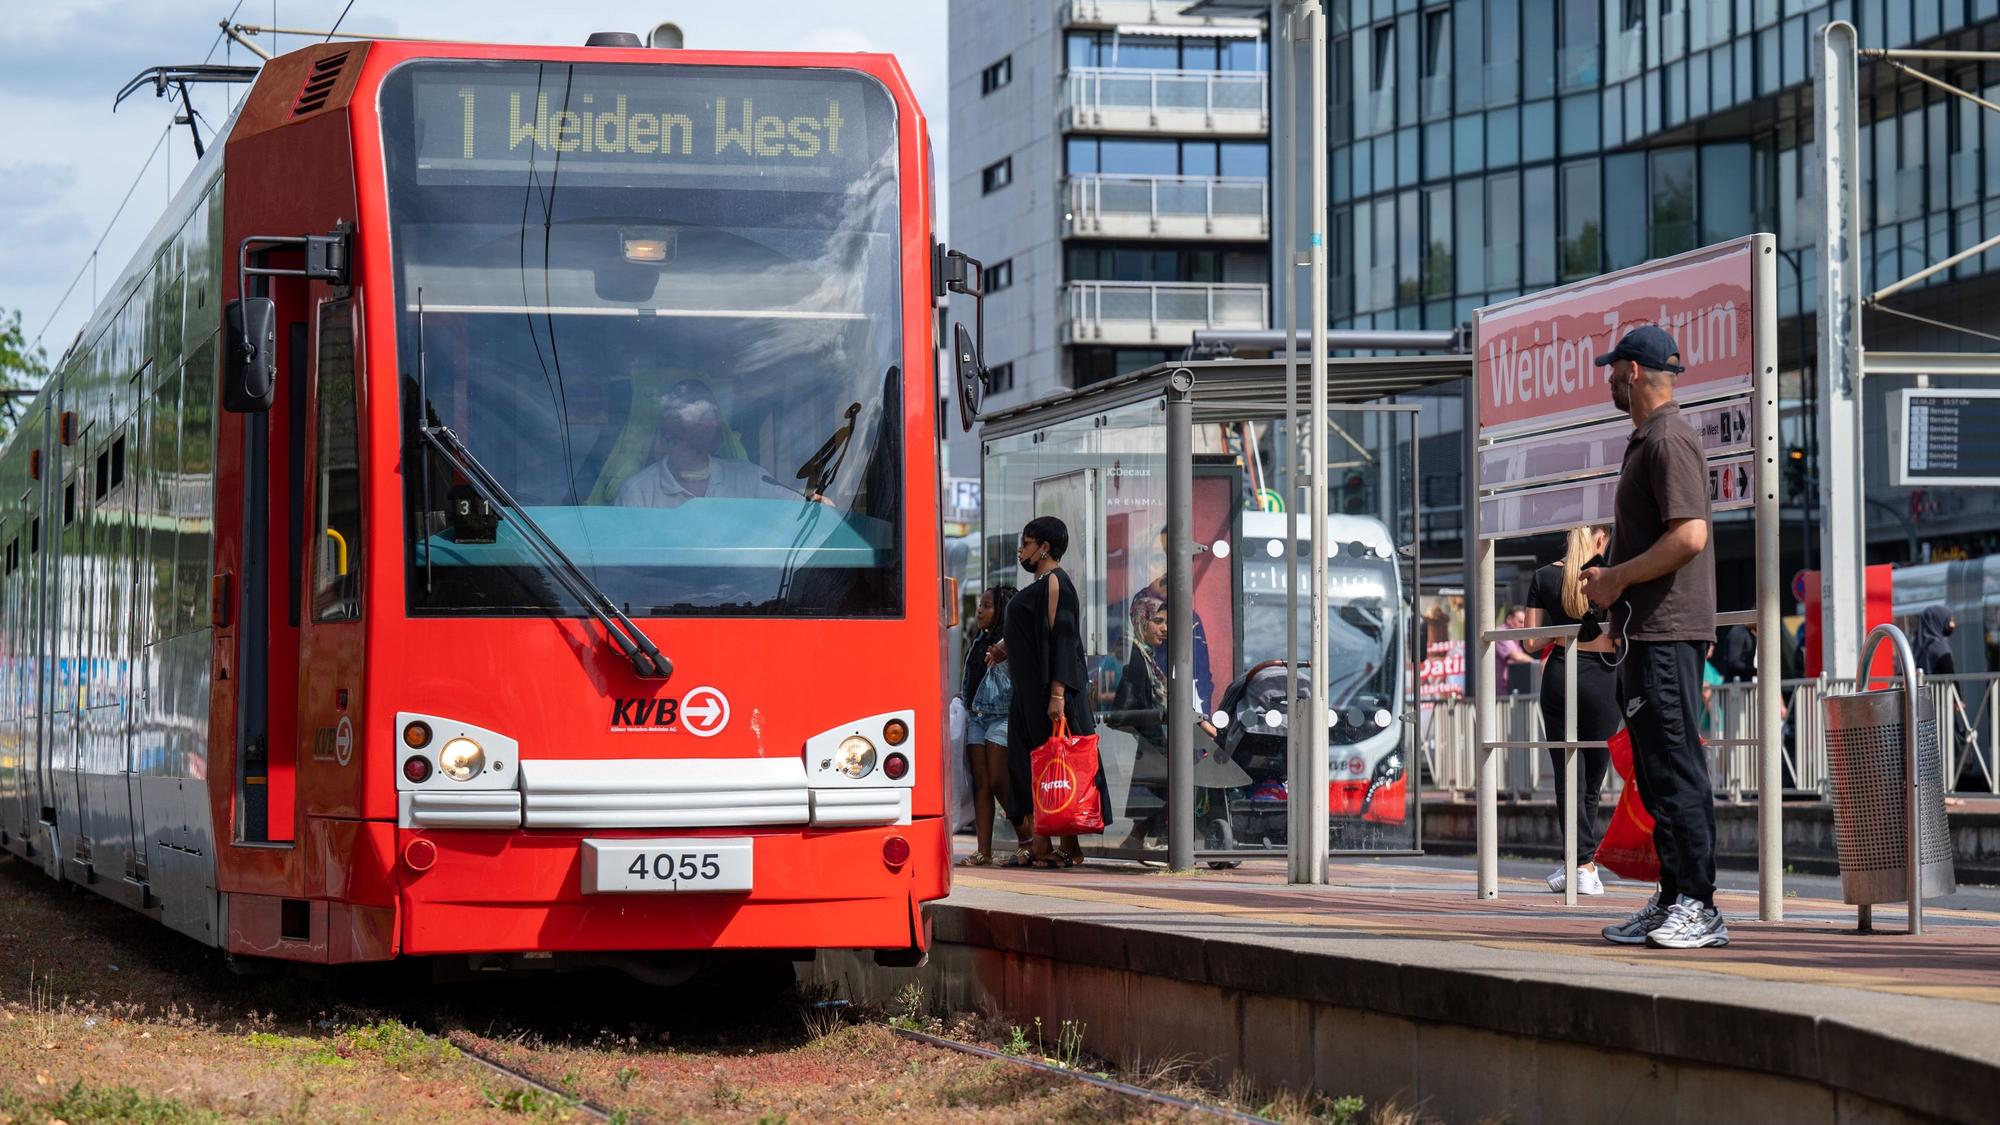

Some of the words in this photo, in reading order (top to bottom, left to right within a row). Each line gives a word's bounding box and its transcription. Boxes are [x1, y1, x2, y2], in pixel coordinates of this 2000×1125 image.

[458, 87, 475, 159] 1
[509, 91, 693, 155] Weiden
[715, 96, 845, 158] West
[1489, 322, 1595, 408] Weiden
[1706, 424, 1720, 436] West
[1124, 498, 1163, 506] EINMAL
[611, 698, 678, 726] KVB
[314, 727, 337, 755] KVB
[628, 853, 720, 880] 4055
